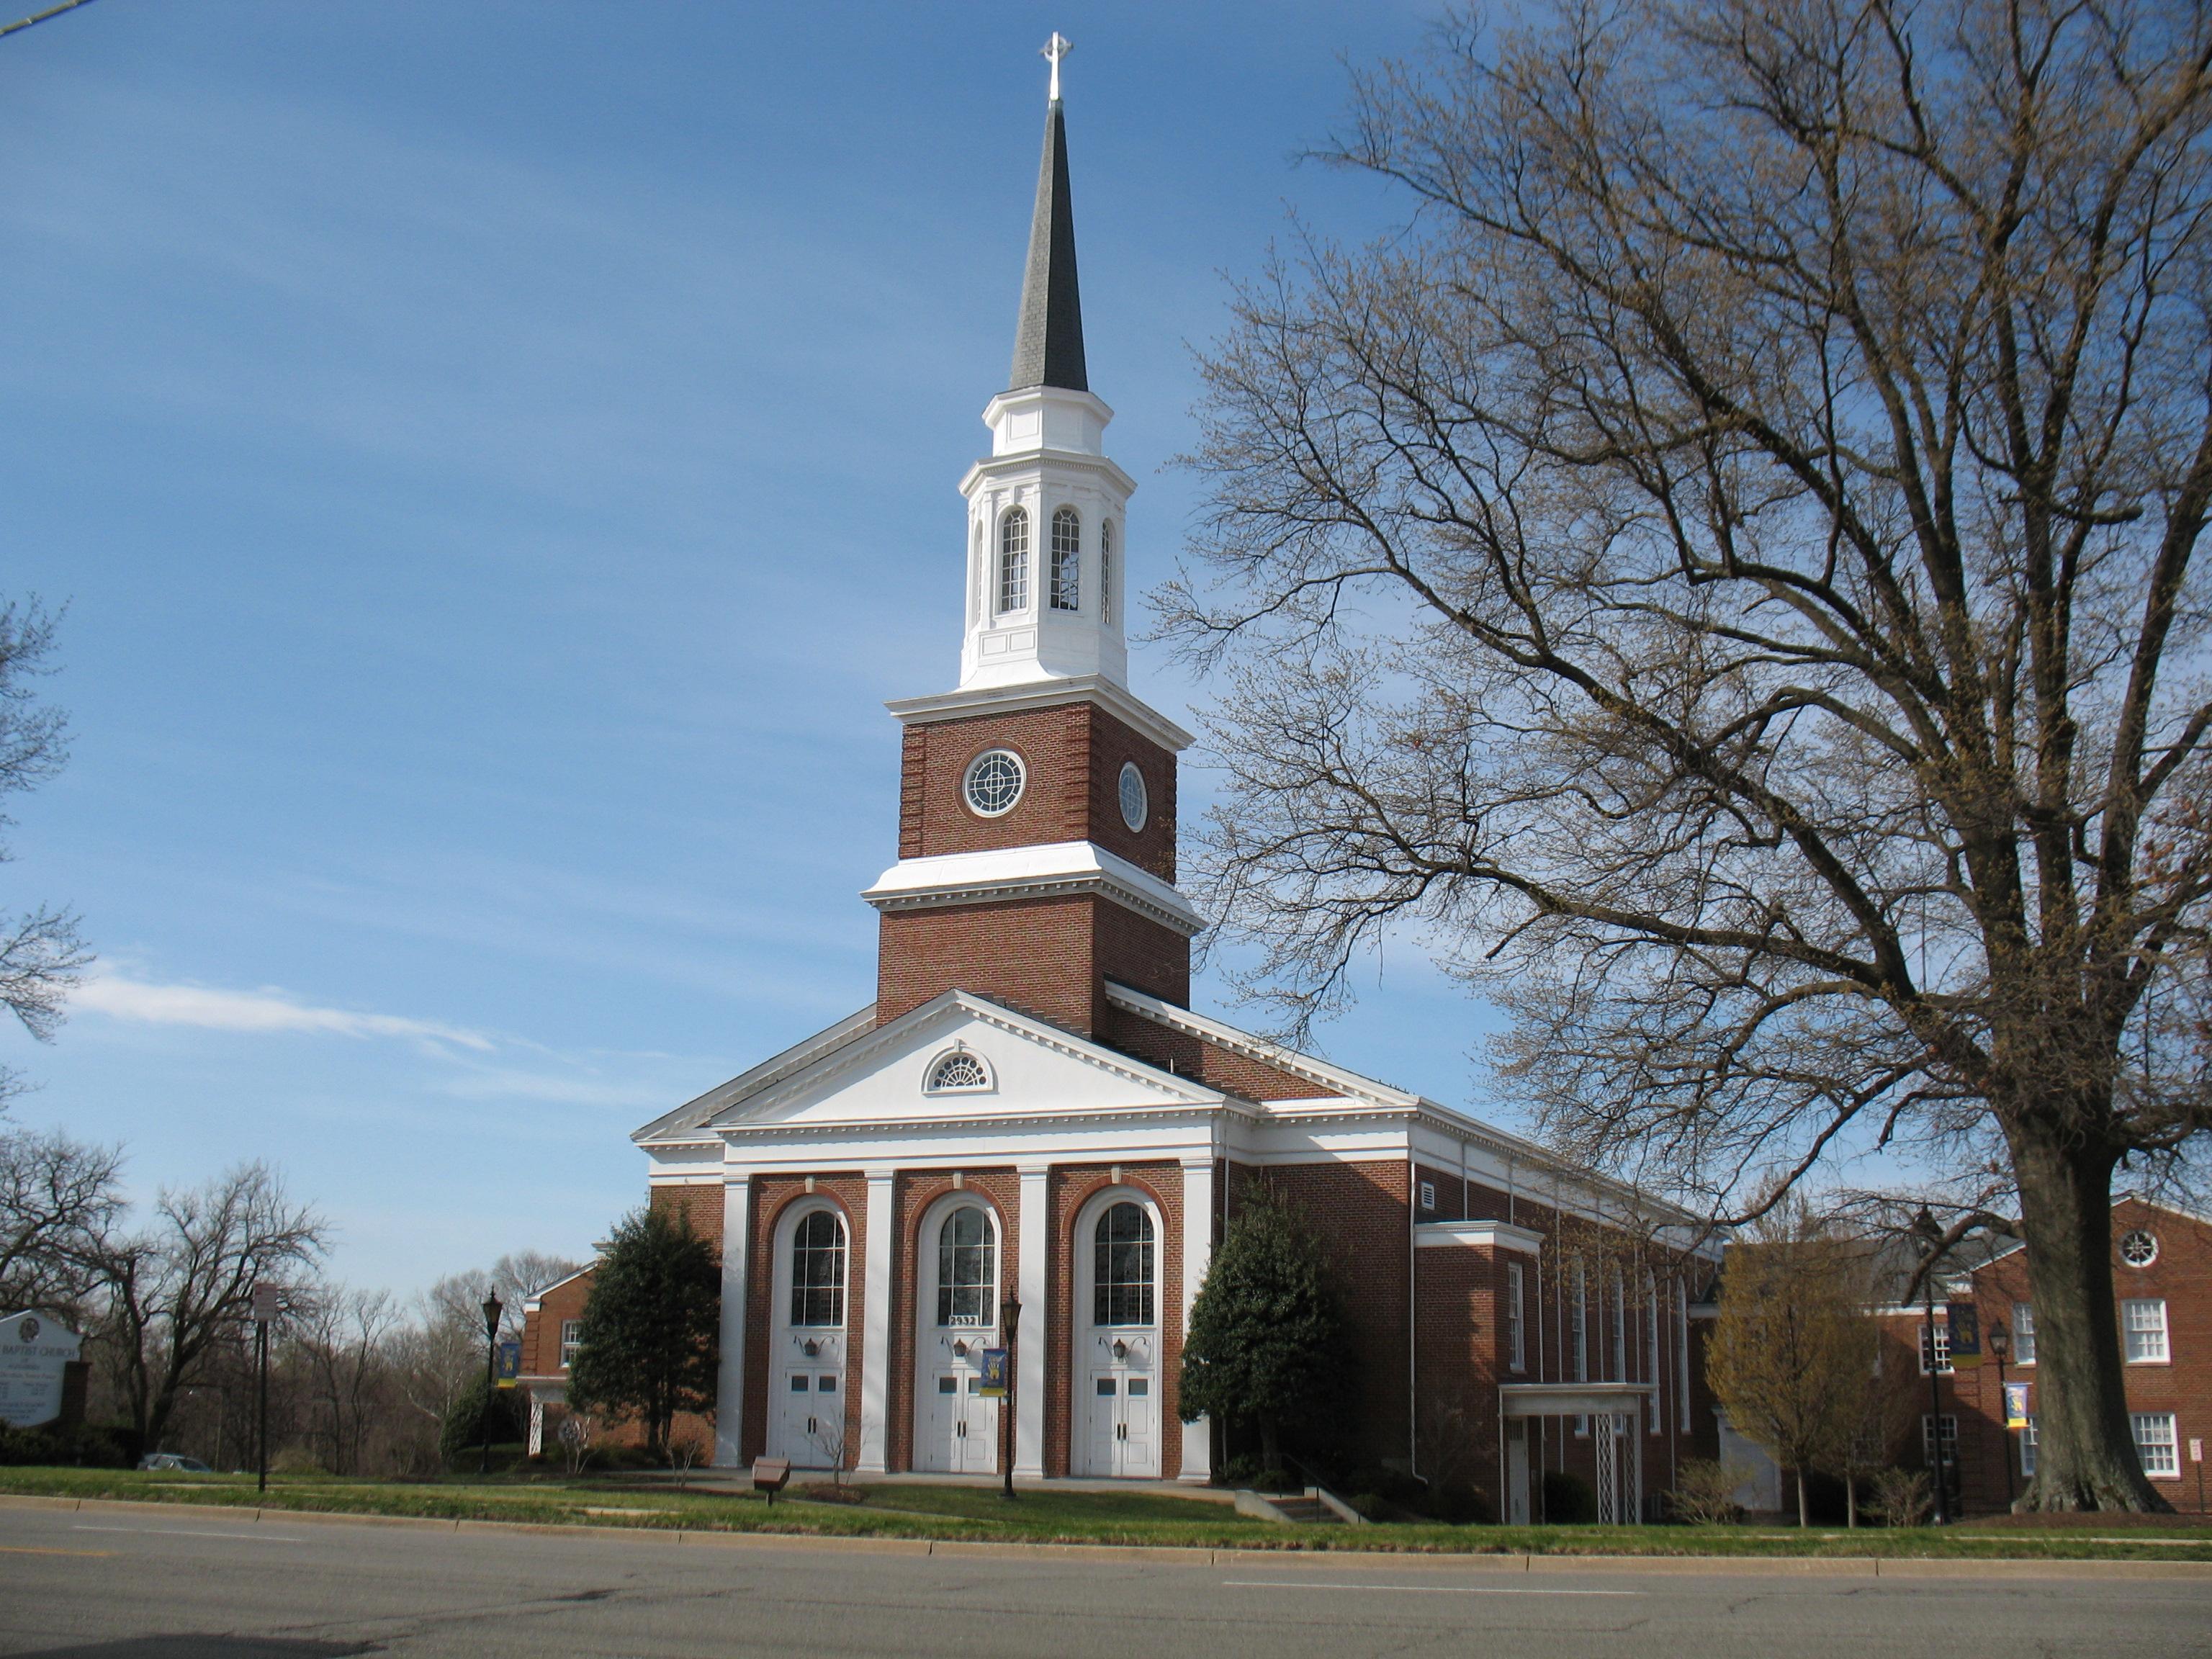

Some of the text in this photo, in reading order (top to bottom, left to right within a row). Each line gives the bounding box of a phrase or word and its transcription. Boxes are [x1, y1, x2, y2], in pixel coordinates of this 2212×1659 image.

[950, 1316, 976, 1325] 2932
[2, 1345, 76, 1357] BAPTIST CHURCH
